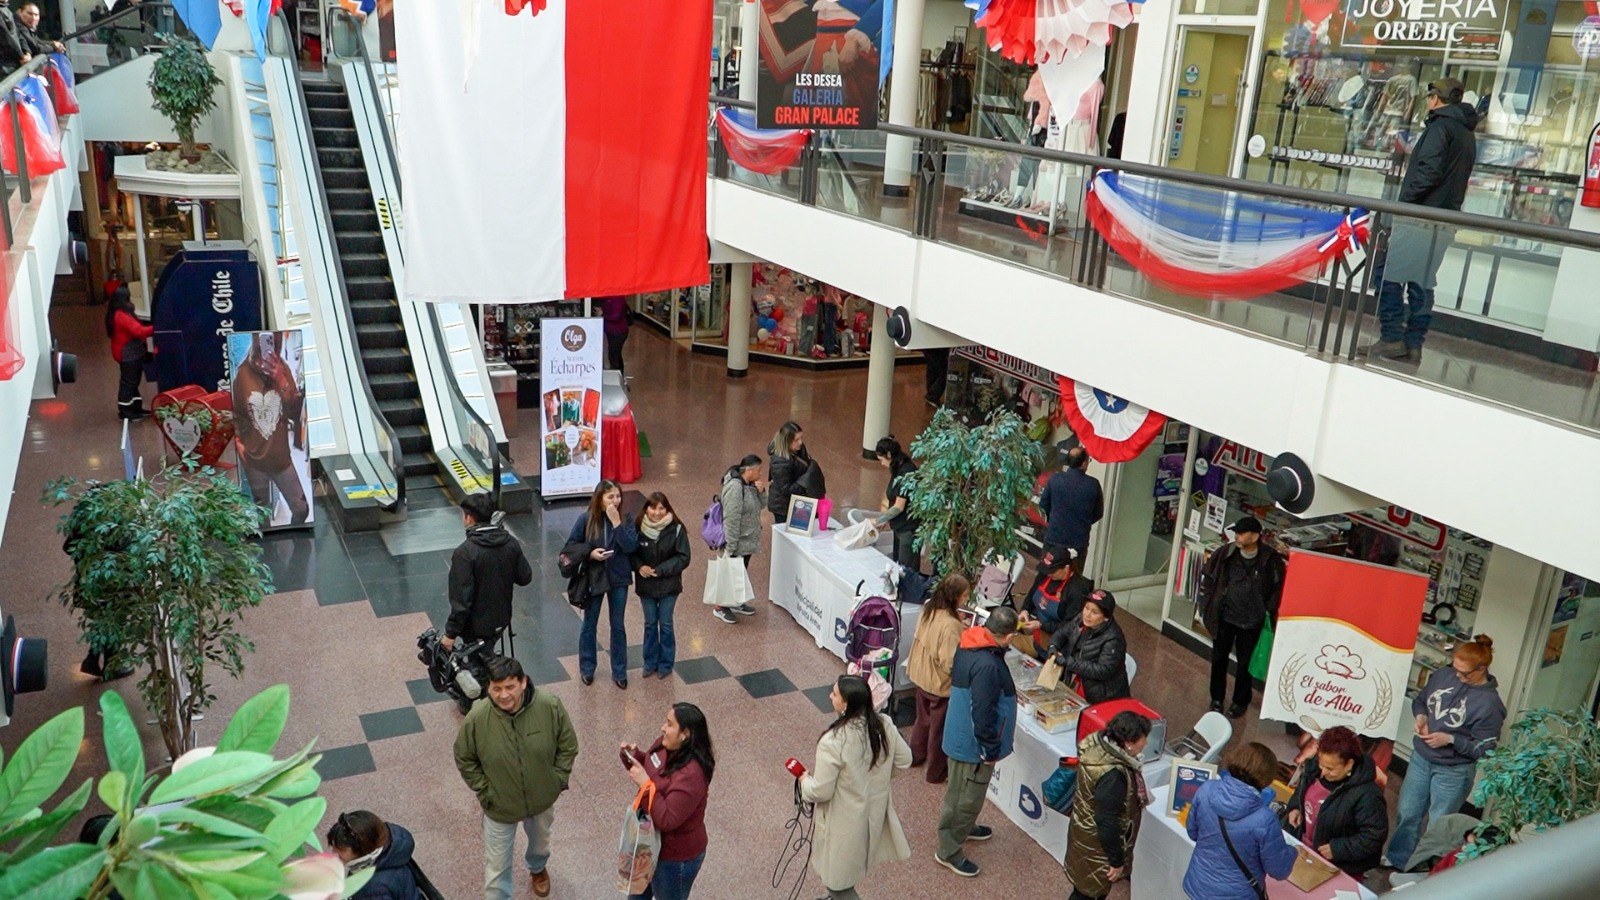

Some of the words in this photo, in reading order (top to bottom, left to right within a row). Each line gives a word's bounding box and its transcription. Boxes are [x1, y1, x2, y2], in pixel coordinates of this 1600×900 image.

[1373, 20, 1468, 42] OREBIC
[1579, 29, 1600, 45] AD
[795, 73, 812, 86] LES
[814, 74, 842, 87] DESEA
[793, 88, 843, 105] GALERIA
[775, 106, 809, 124] GRAN
[812, 107, 860, 125] PALACE
[212, 270, 234, 314] Chile
[564, 329, 583, 346] Olga
[550, 356, 596, 377] Écharpes
[1300, 674, 1314, 688] El
[1315, 680, 1347, 694] sabor
[1304, 689, 1323, 706] de
[1324, 694, 1364, 715] Alba
